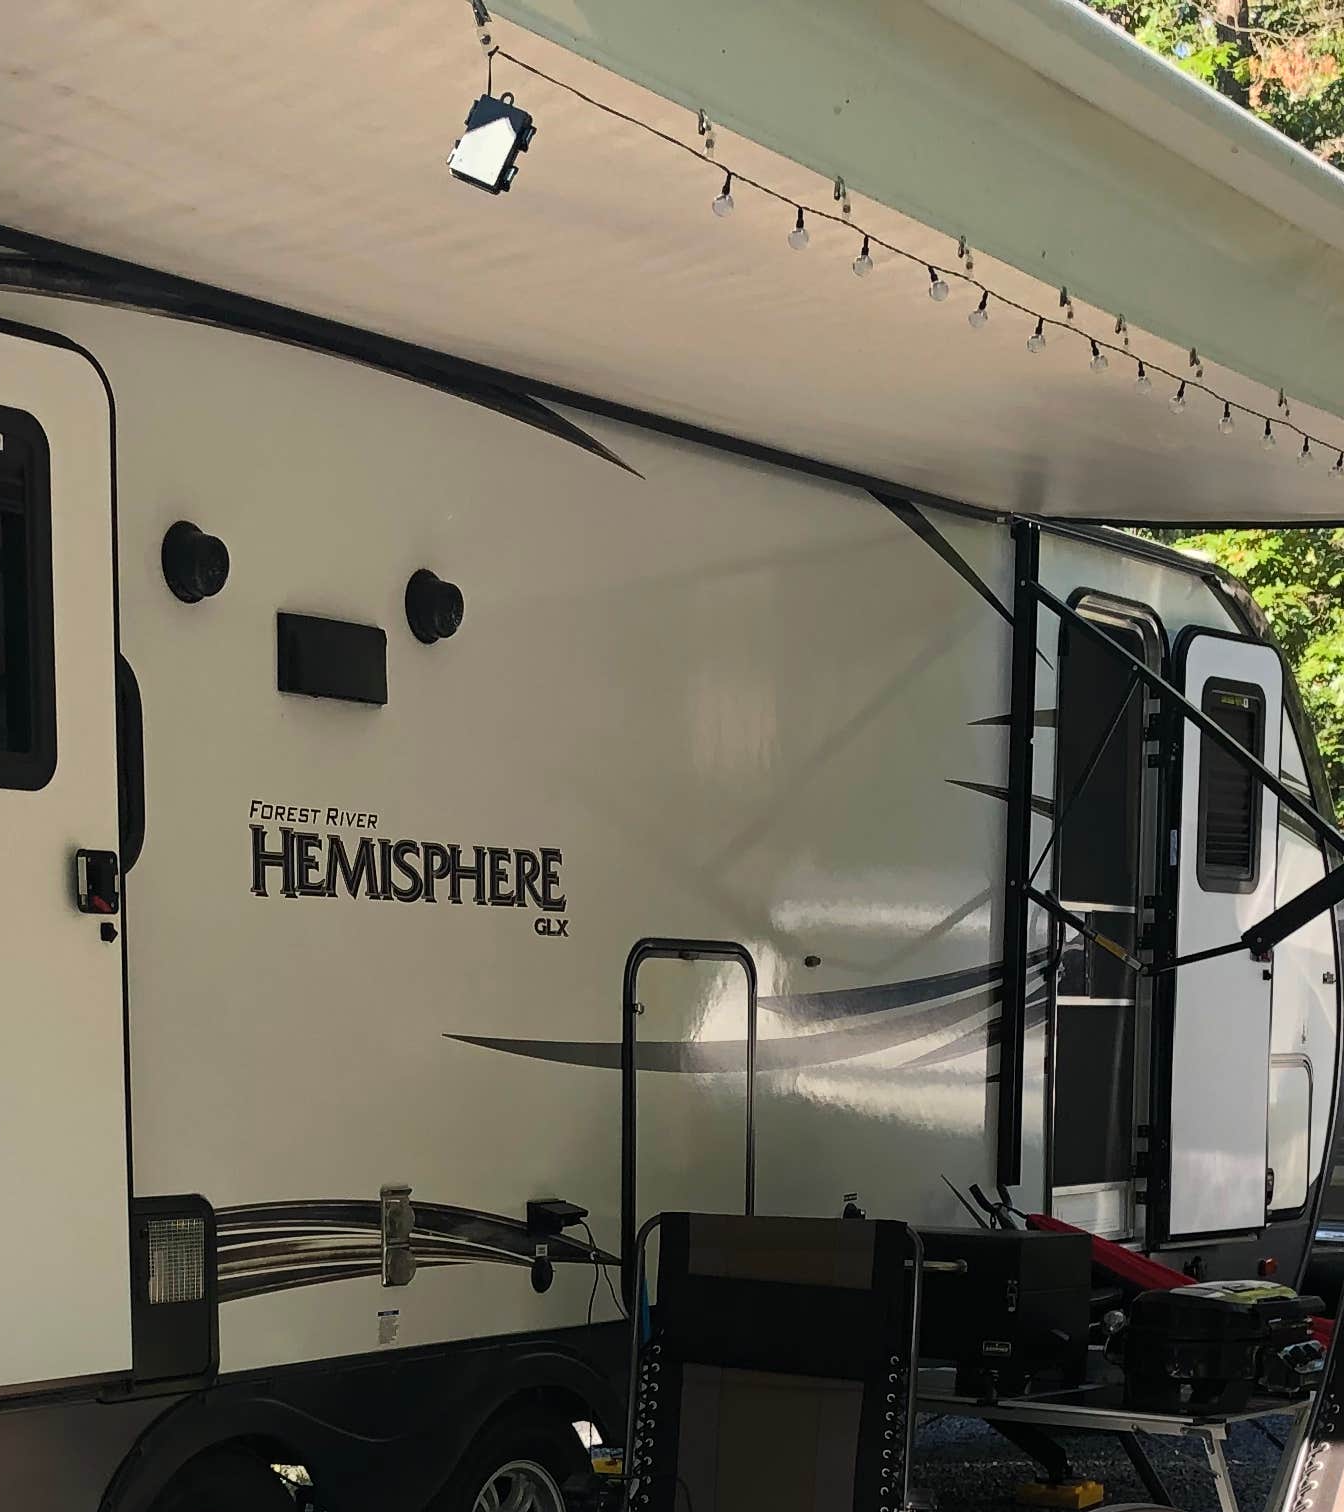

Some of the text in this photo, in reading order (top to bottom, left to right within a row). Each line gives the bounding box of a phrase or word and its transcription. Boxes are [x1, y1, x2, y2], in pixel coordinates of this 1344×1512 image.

[249, 799, 378, 829] FOREST RIVER
[249, 824, 567, 912] HEMISPHERE
[534, 918, 569, 937] GLX
